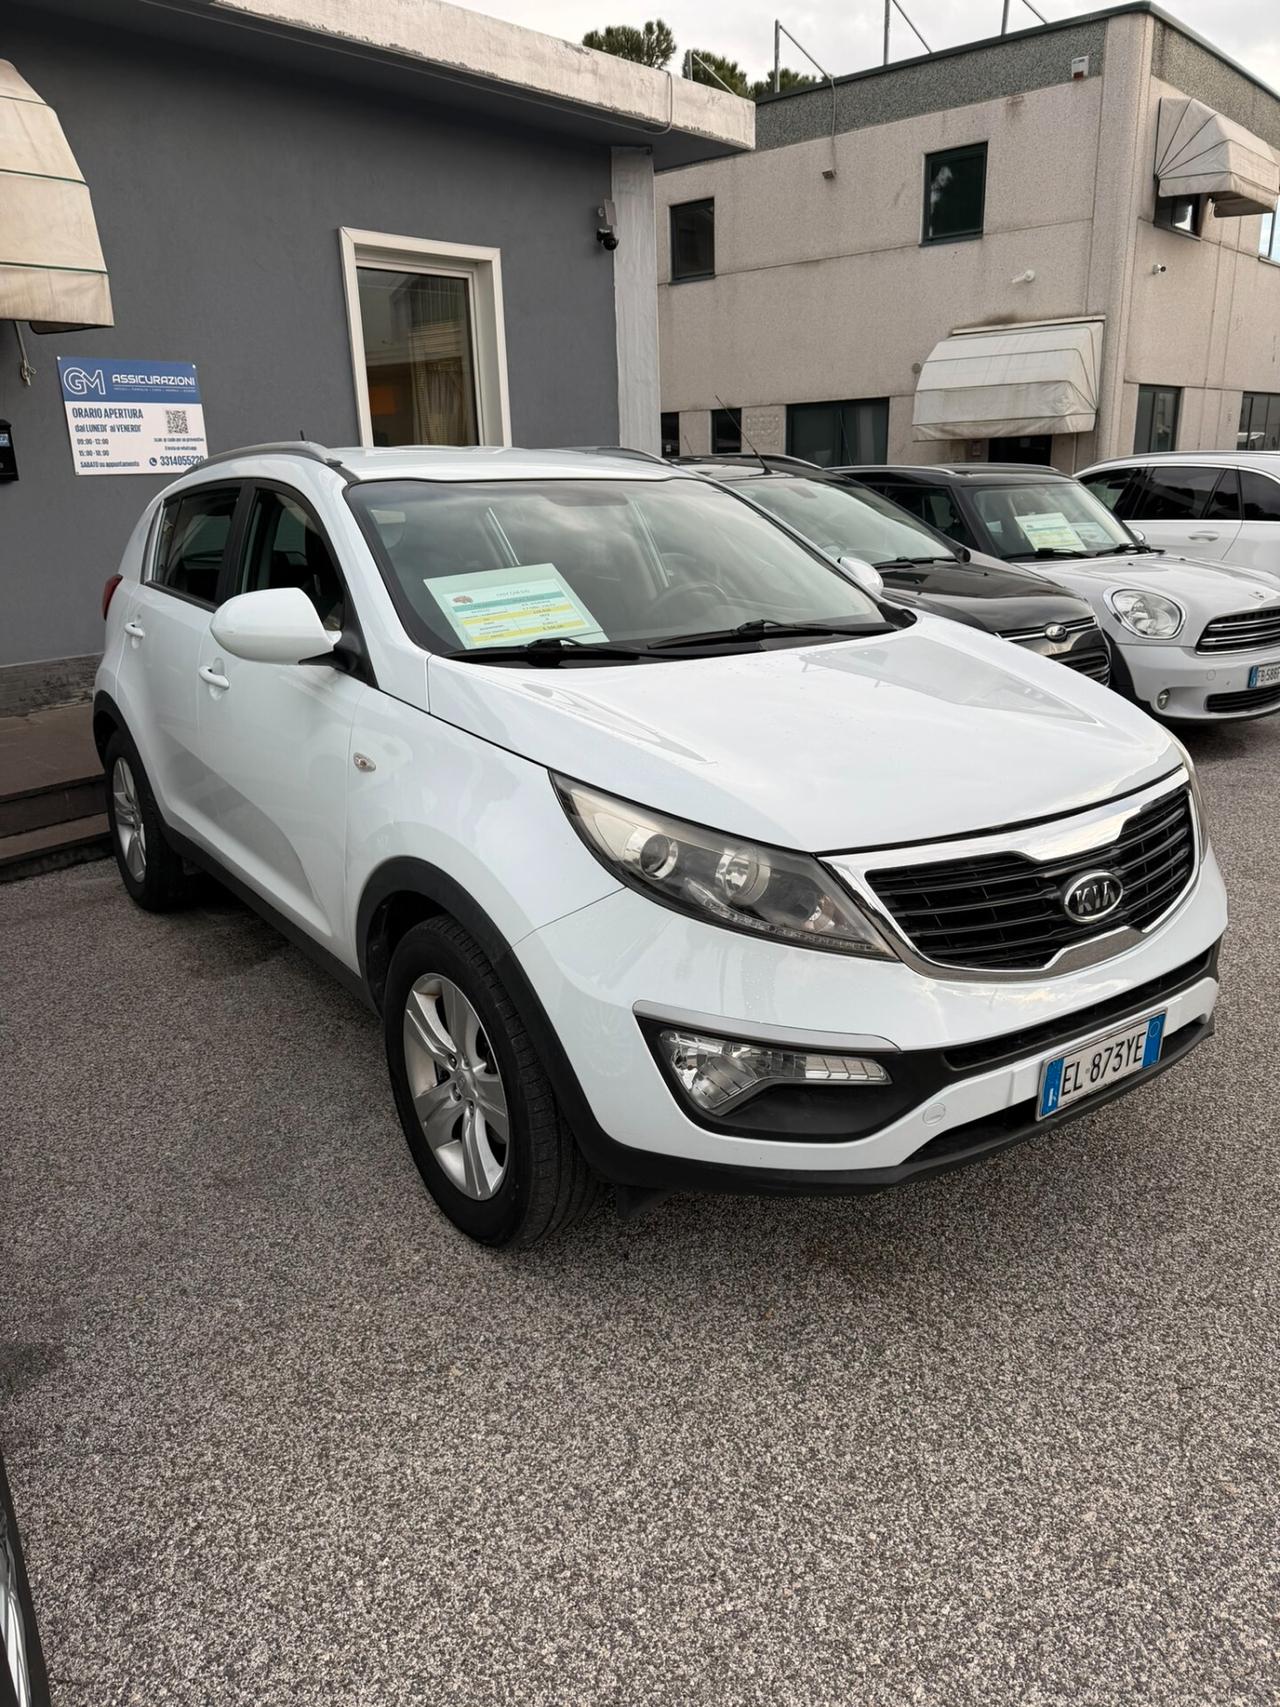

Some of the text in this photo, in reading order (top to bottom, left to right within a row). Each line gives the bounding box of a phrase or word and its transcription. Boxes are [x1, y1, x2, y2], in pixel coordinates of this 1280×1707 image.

[63, 366, 196, 395] GM ASSICURAZIONI
[72, 407, 144, 419] ORARIO APERTURA
[75, 424, 85, 433] dal
[110, 424, 116, 433] al
[1074, 880, 1117, 915] KIA
[1060, 1061, 1083, 1097] EL
[1090, 1031, 1147, 1083] 873YE
